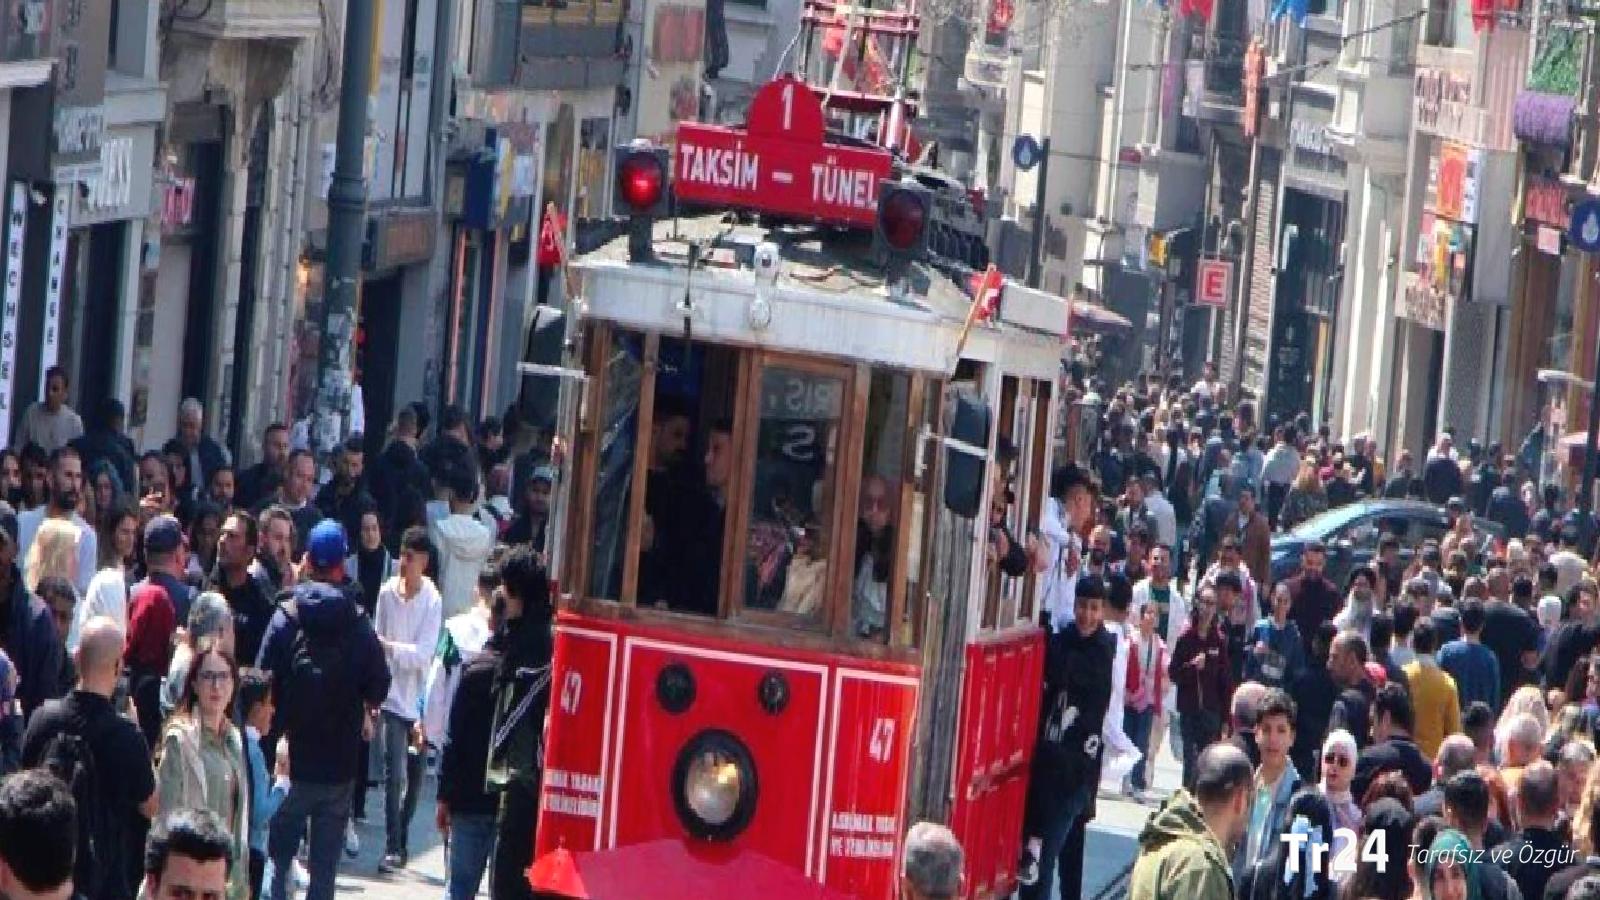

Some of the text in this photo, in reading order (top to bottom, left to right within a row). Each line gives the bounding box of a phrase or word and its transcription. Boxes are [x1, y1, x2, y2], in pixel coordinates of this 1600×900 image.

[781, 84, 794, 130] 1
[680, 140, 758, 190] TAKSİM
[811, 156, 878, 209] TÜNEL
[1207, 270, 1225, 298] E
[560, 671, 582, 714] 47
[870, 718, 896, 761] 47
